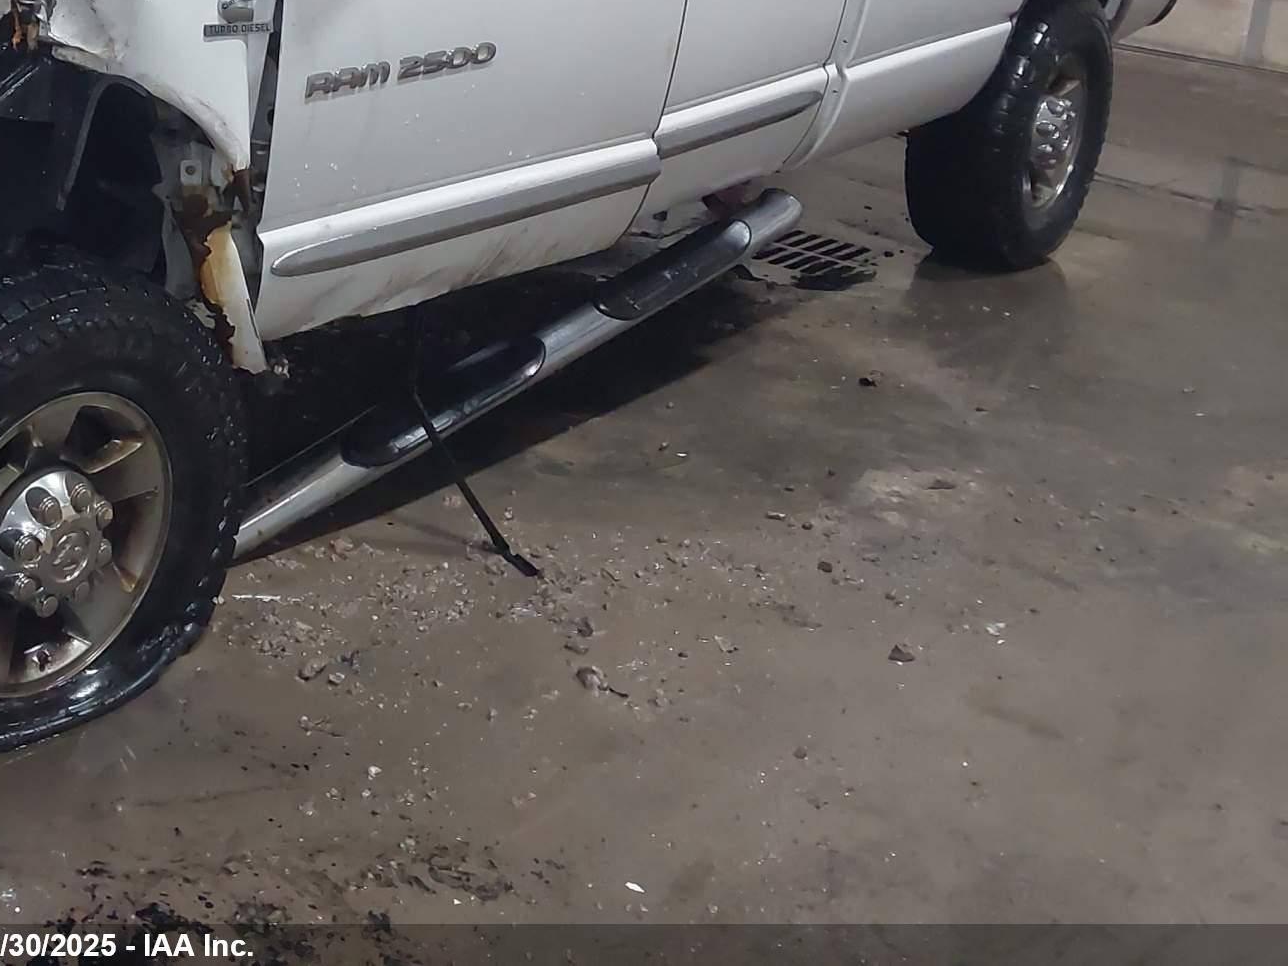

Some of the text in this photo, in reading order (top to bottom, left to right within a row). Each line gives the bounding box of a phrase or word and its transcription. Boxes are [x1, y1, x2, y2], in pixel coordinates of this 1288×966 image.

[209, 22, 271, 34] TURBO DIESEL
[305, 42, 497, 98] RAM 2500
